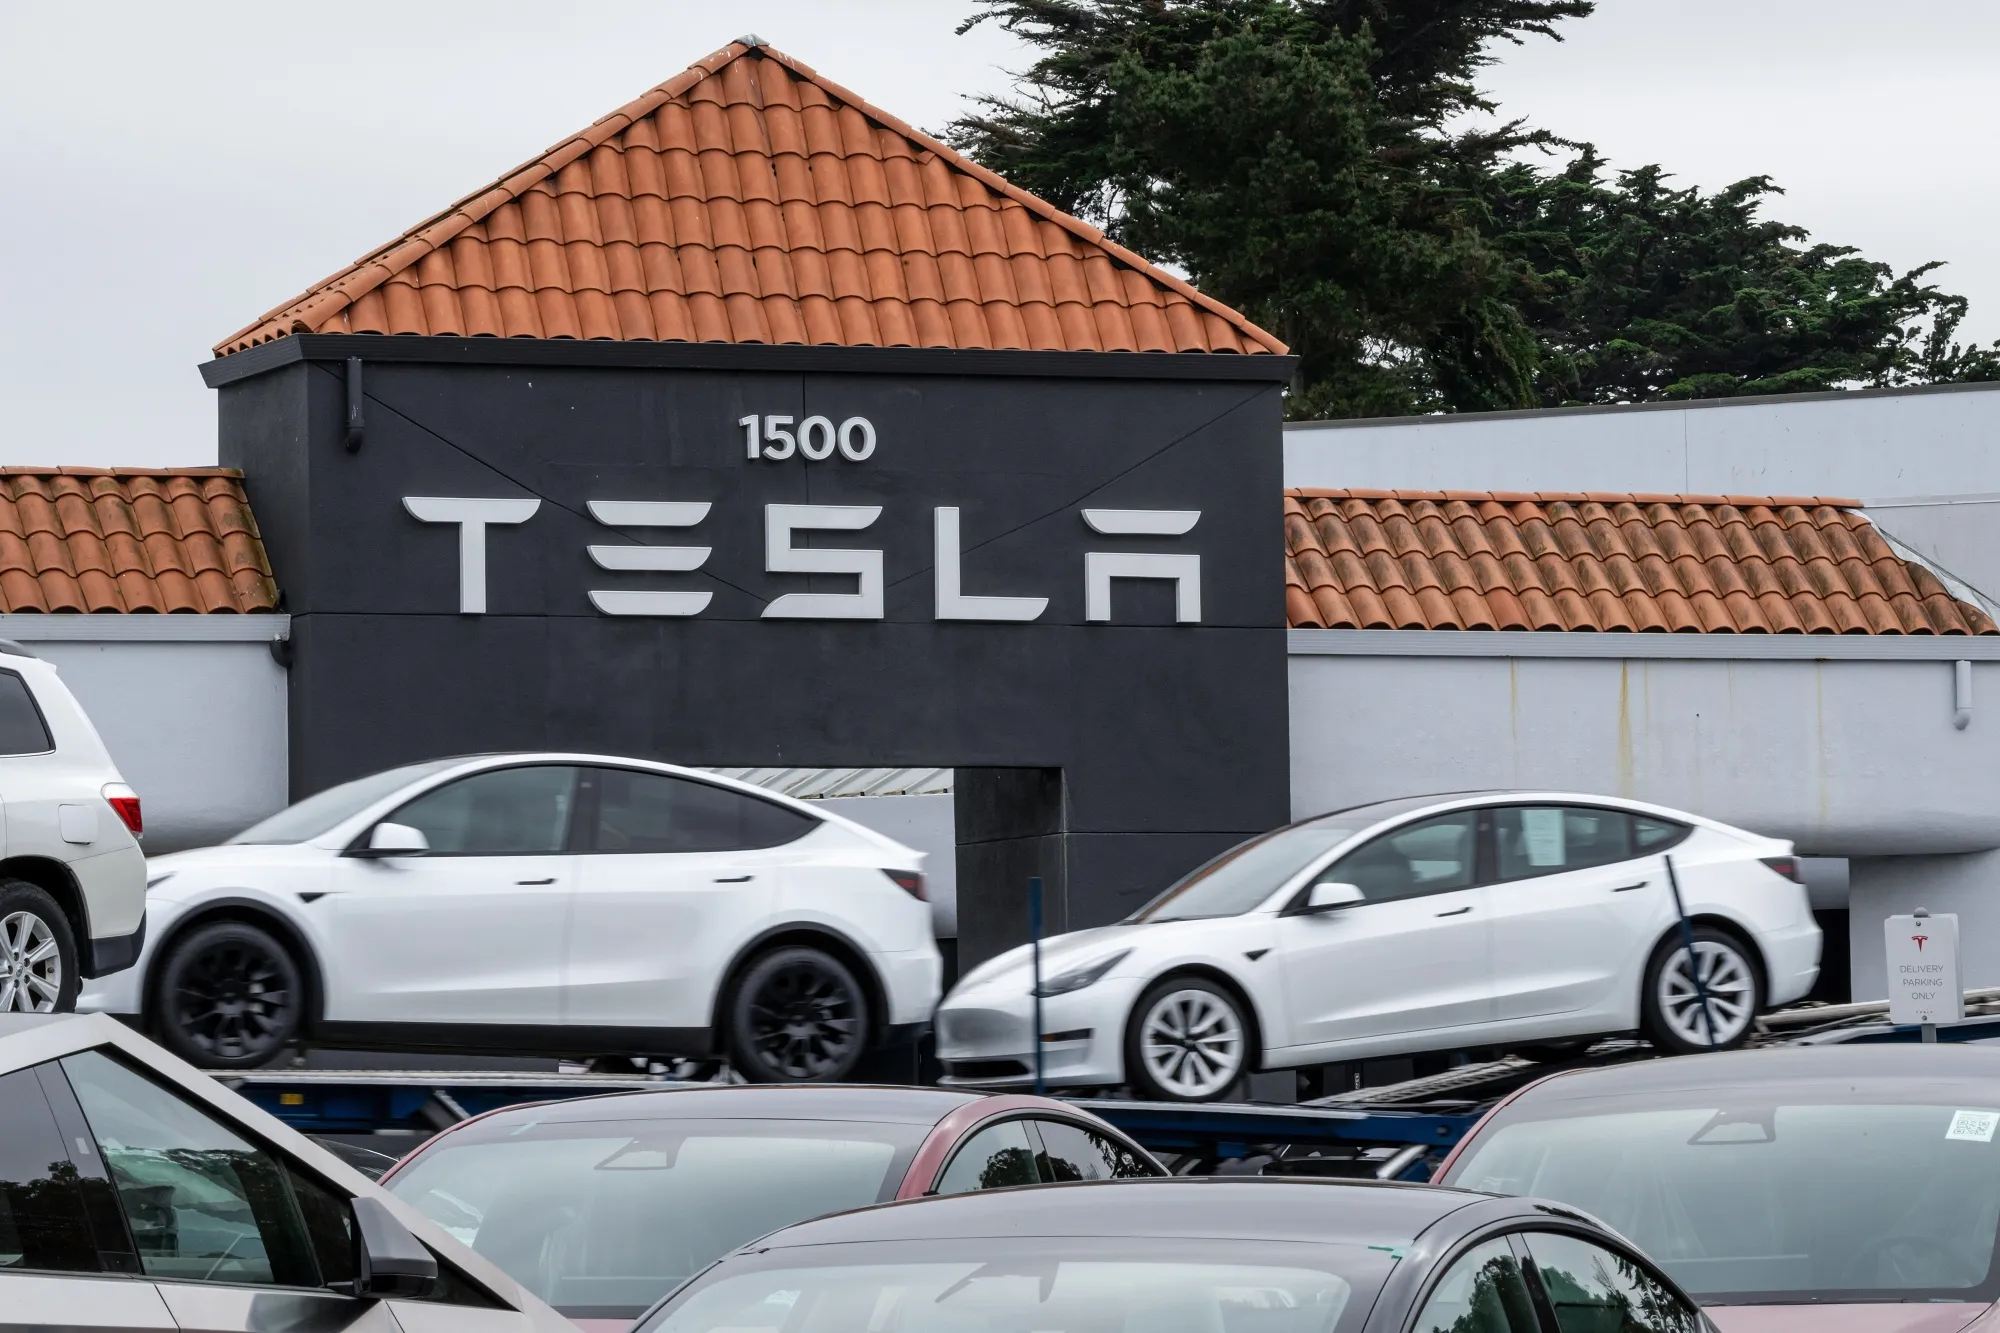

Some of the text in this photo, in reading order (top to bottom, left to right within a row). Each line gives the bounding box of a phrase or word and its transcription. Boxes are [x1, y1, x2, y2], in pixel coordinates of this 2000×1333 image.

[738, 415, 877, 461] 1500
[402, 495, 1202, 622] TESLA
[1899, 965, 1944, 973] DELIVERY
[1902, 978, 1943, 986] PARKING
[1911, 992, 1936, 1000] ONLY
